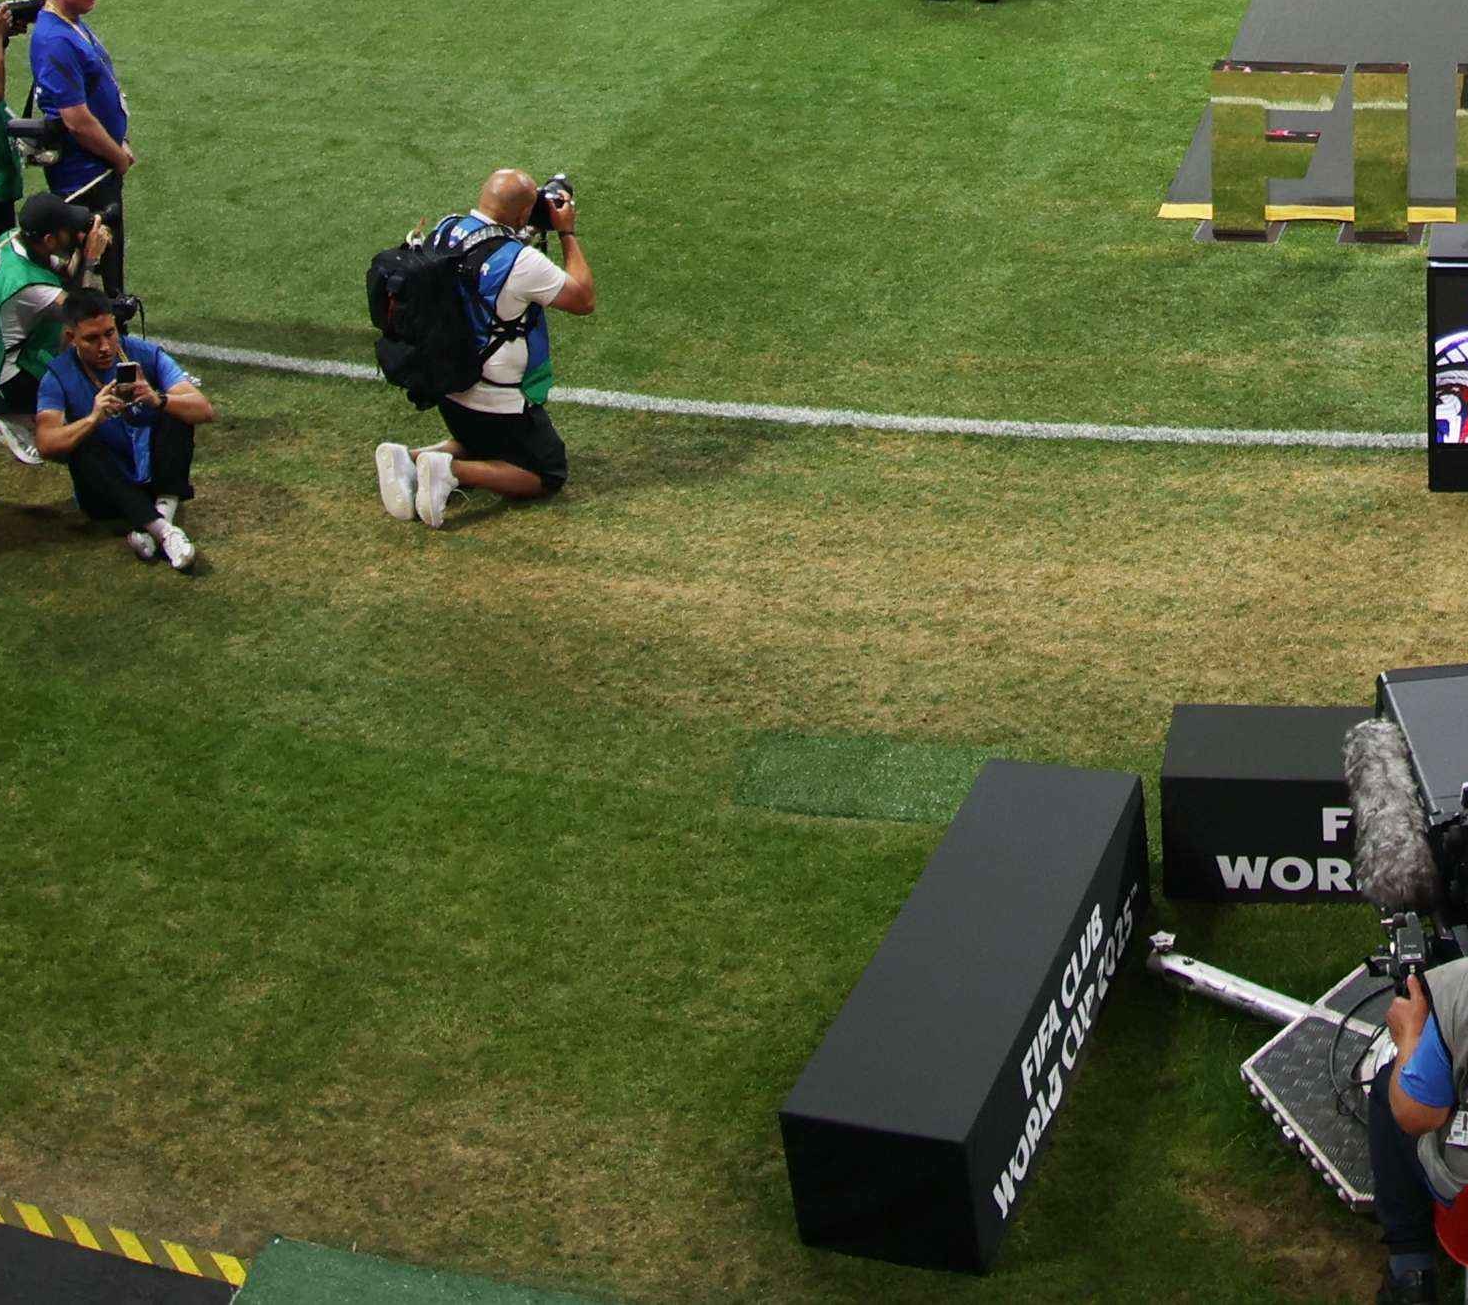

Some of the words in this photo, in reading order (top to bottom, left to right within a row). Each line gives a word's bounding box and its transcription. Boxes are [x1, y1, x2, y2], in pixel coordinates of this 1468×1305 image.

[1216, 854, 1364, 892] WOR
[1020, 998, 1063, 1100] FIFA
[1060, 902, 1104, 1009] CLUB
[992, 1061, 1063, 1220] WORLD
[1061, 983, 1096, 1071] CUP
